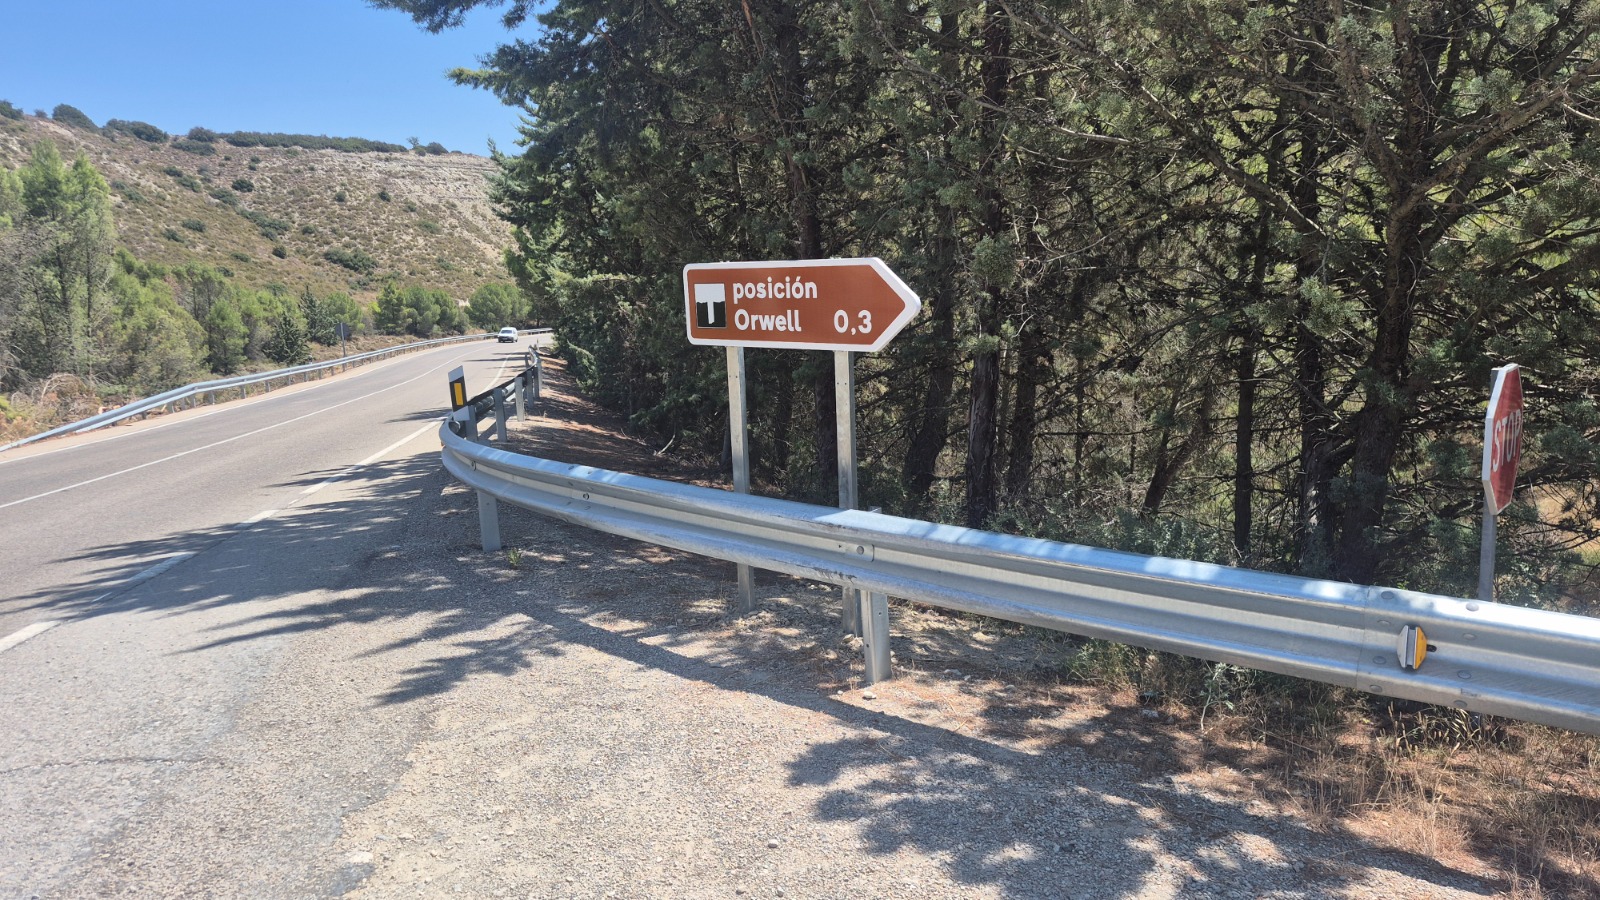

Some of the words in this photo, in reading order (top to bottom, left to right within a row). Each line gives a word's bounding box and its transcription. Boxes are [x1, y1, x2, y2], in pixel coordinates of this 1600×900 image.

[732, 276, 818, 304] posición
[734, 308, 802, 332] Orwell
[833, 309, 873, 336] 0,3
[1492, 408, 1522, 473] STOP
